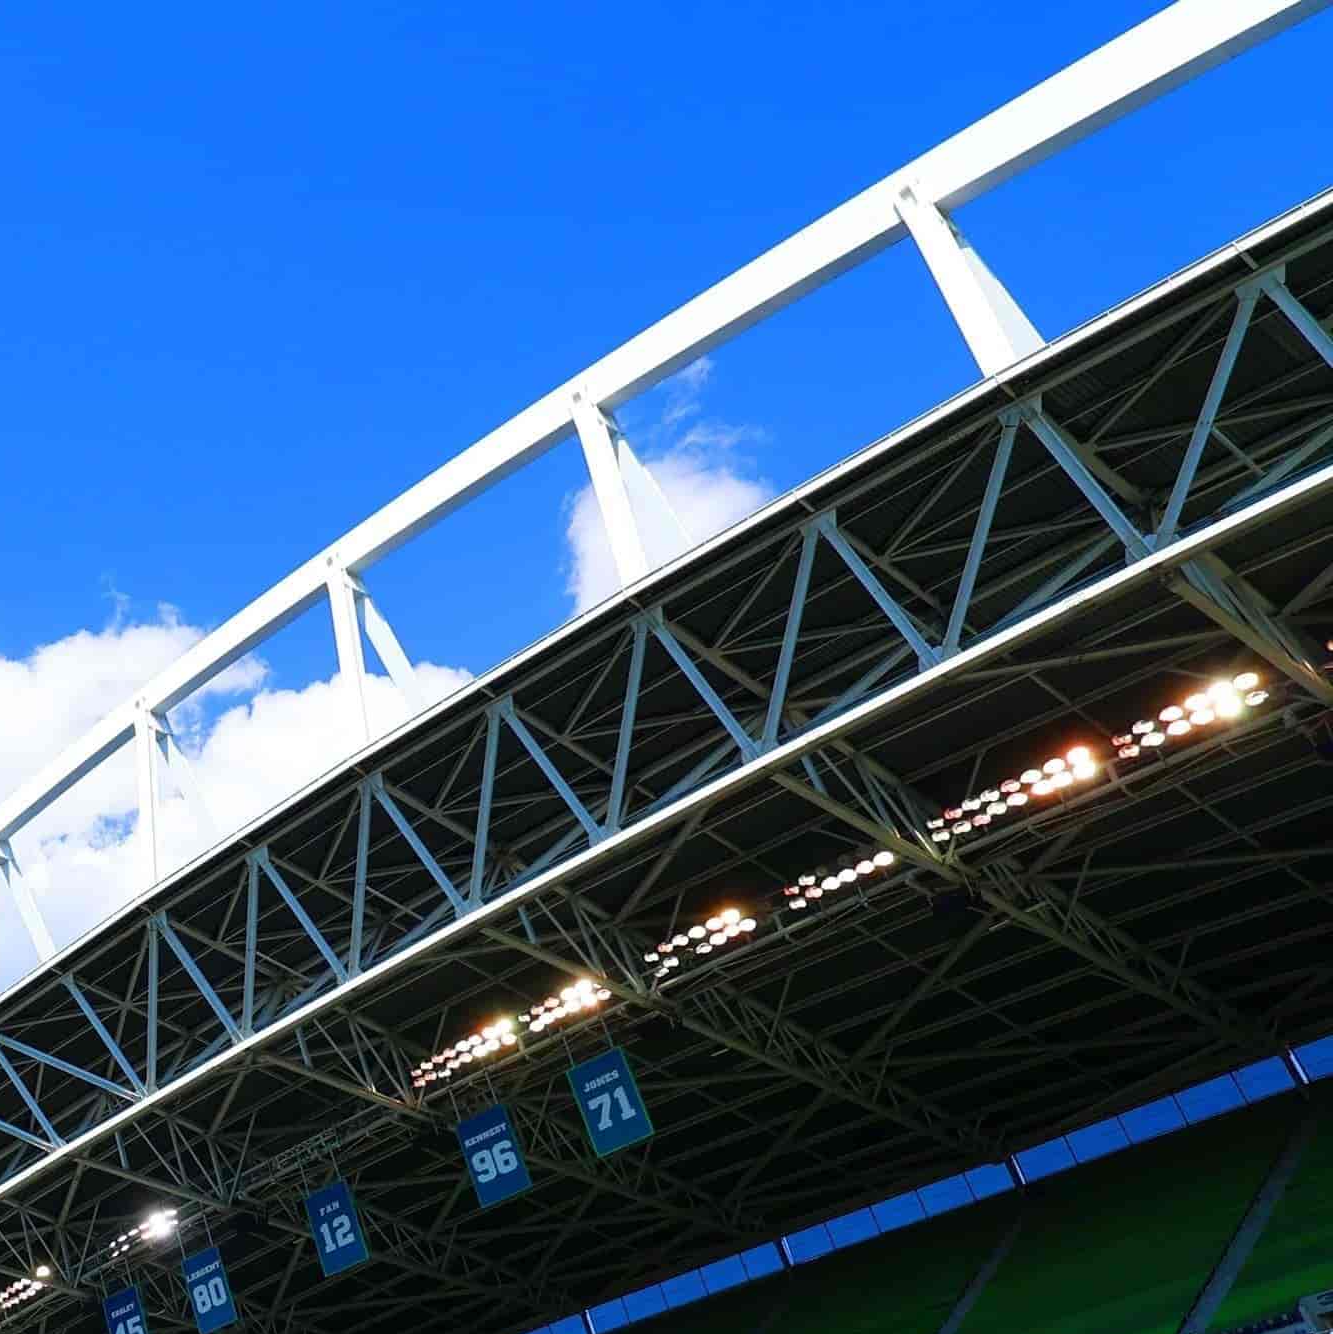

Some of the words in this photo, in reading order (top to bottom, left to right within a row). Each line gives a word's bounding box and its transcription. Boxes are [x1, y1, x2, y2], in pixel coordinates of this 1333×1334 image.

[583, 1069, 620, 1093] JONES
[586, 1085, 637, 1132] 71
[471, 1139, 518, 1183] 96
[319, 1213, 356, 1254] 12
[193, 1276, 227, 1314] 80
